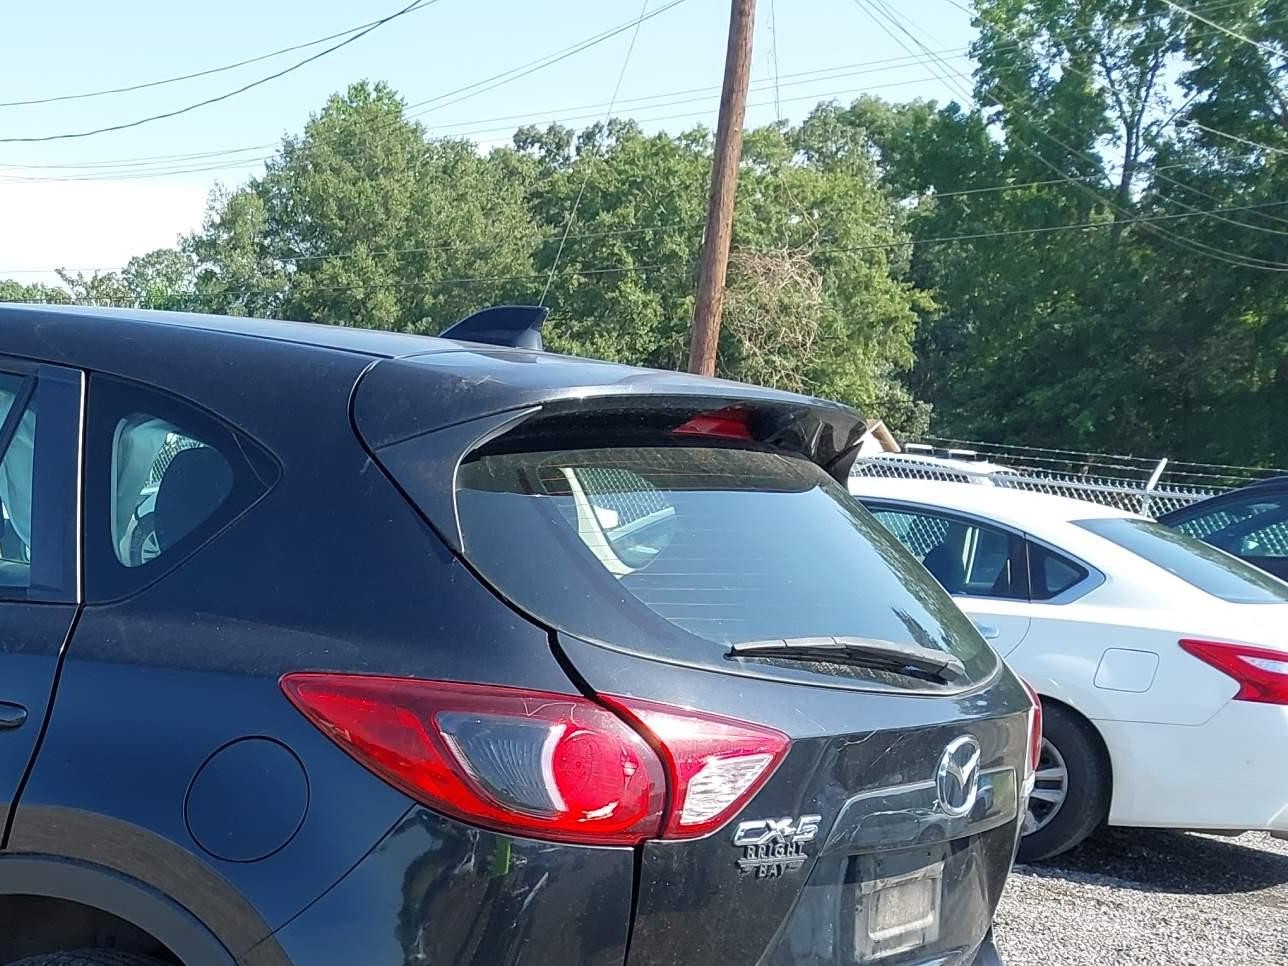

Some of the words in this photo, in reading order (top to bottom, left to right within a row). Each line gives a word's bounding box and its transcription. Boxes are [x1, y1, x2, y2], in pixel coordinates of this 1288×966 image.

[734, 815, 822, 846] CX-5
[746, 842, 806, 860] BRIGHT
[758, 863, 787, 877] BAY
